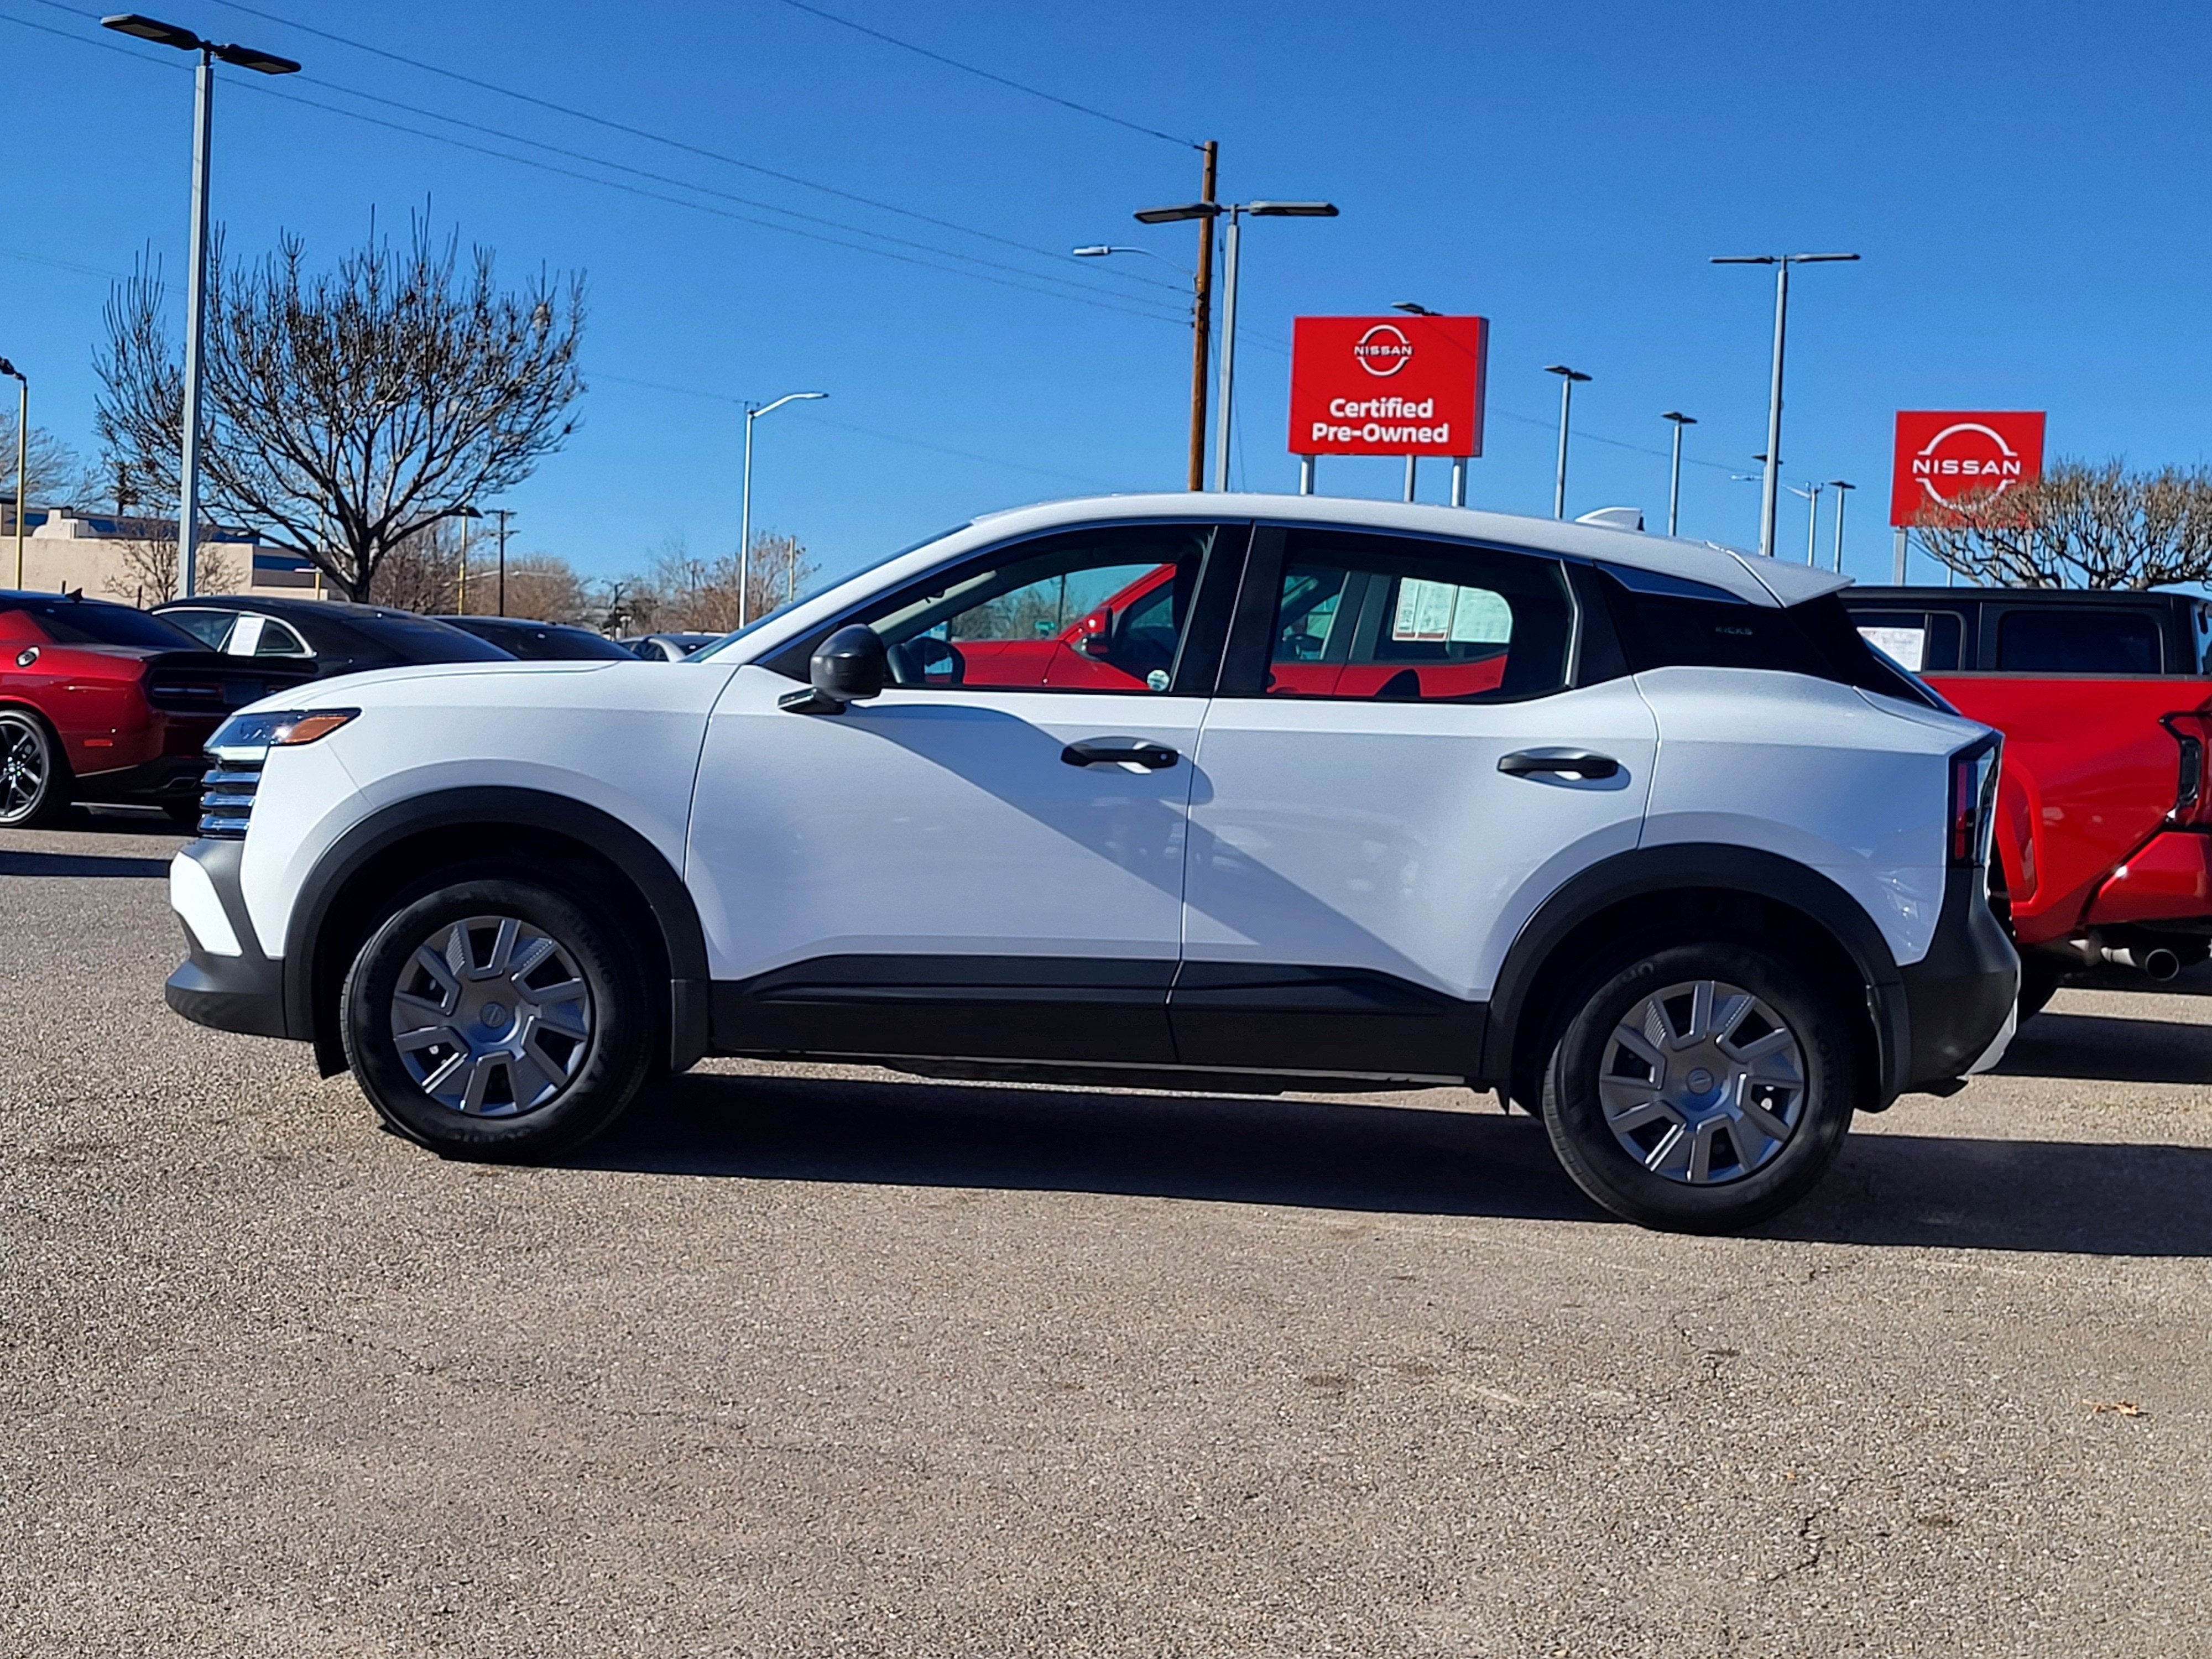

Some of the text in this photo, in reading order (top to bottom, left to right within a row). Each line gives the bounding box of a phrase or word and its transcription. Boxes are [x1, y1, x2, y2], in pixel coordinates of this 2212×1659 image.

[1353, 346, 1413, 356] NISSAN
[1329, 397, 1434, 419] Certified
[1311, 422, 1449, 443] Pre-Owned
[1912, 458, 2021, 476] NISSAN
